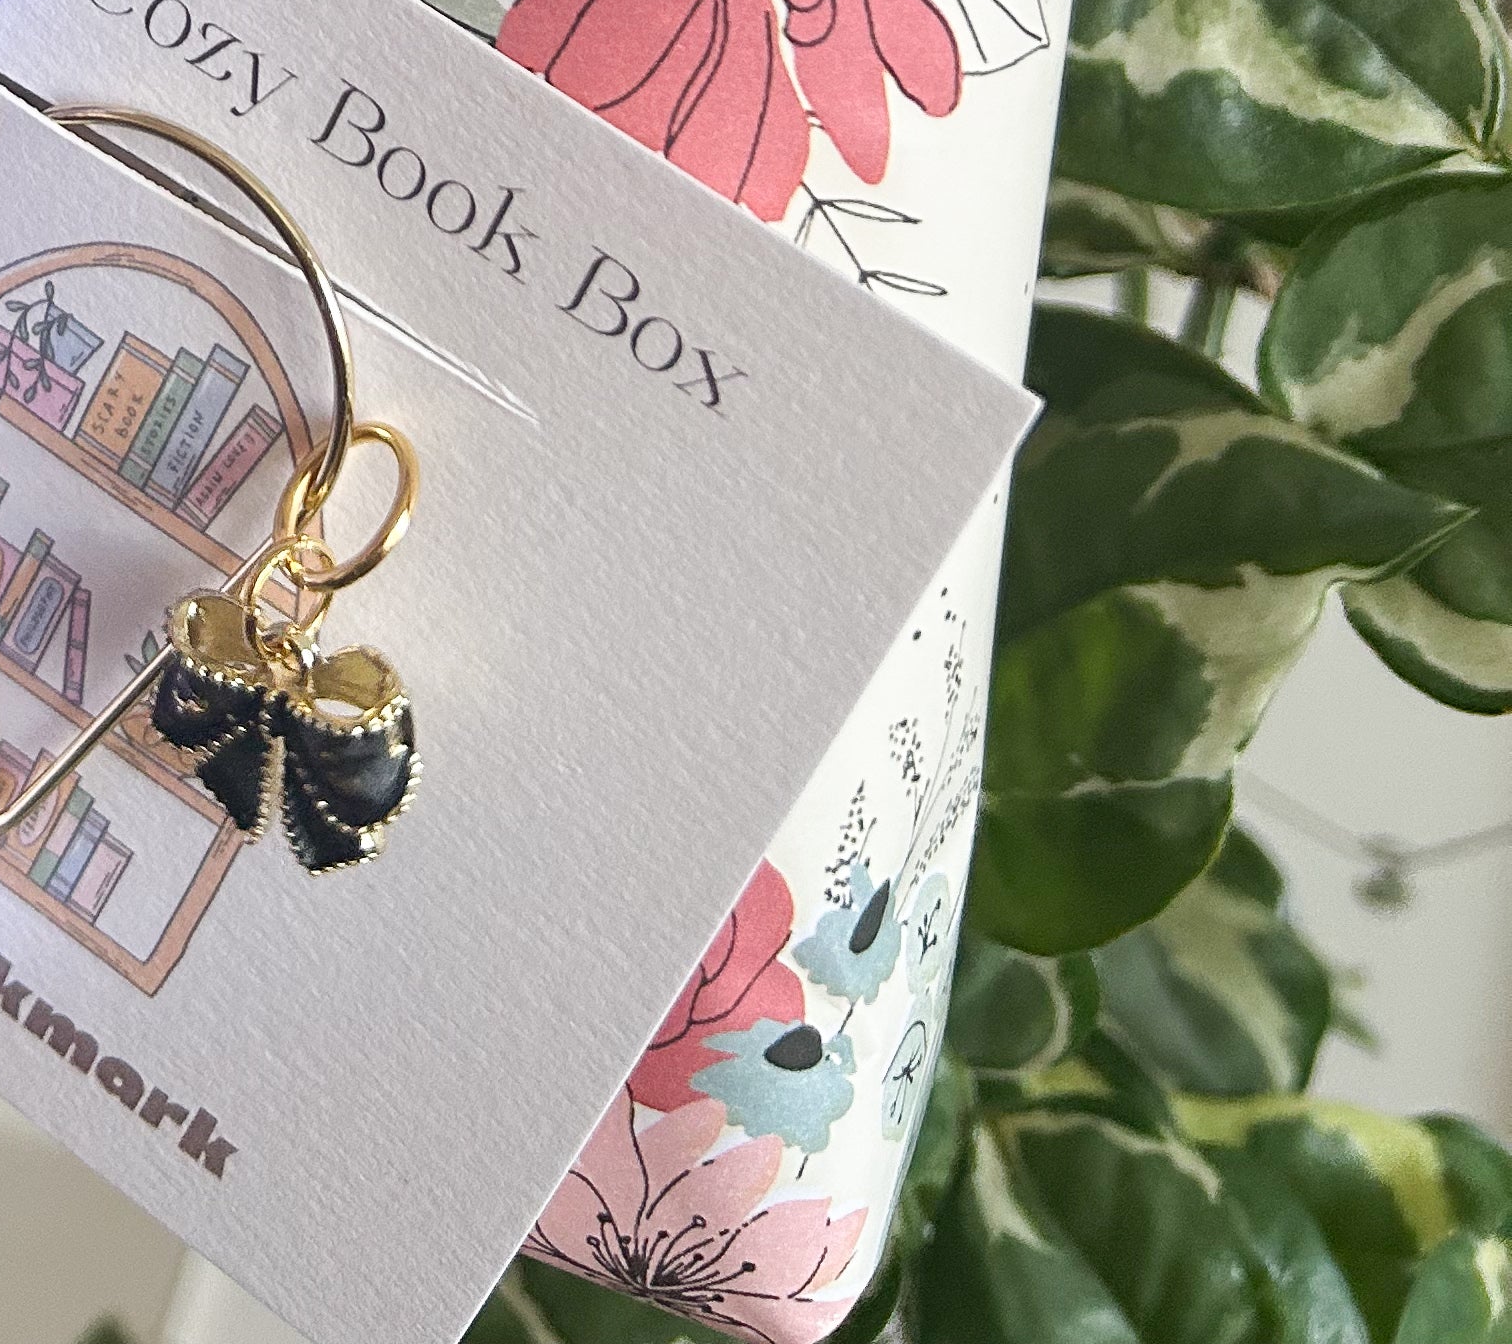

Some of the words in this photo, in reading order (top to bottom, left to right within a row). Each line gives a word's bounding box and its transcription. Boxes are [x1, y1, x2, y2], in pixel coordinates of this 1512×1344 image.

[310, 77, 541, 286] Book
[557, 245, 750, 419] Box
[91, 370, 127, 435] SCARY
[166, 409, 206, 474] FICTION
